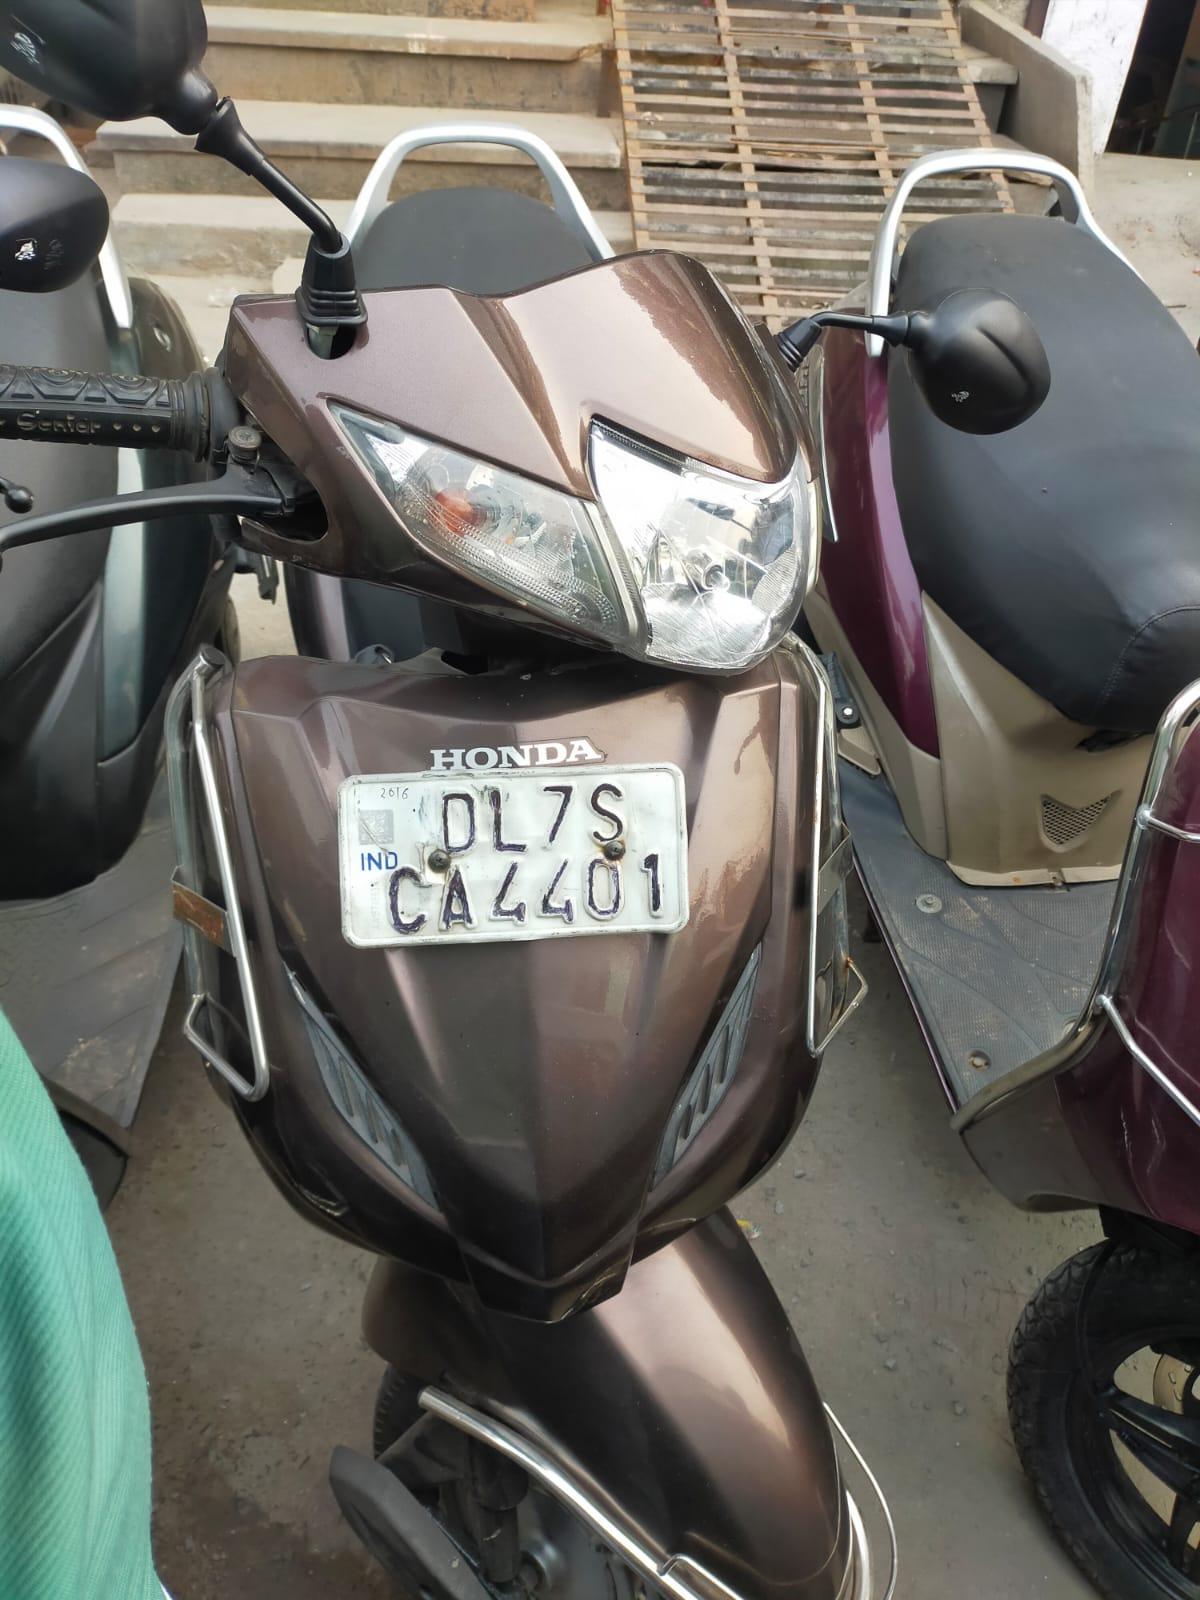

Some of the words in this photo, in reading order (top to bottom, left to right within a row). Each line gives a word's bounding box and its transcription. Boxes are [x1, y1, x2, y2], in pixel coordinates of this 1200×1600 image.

[430, 739, 601, 771] HONDA
[380, 786, 409, 800] 2016
[361, 851, 398, 871] IND
[388, 853, 662, 934] CA4401
